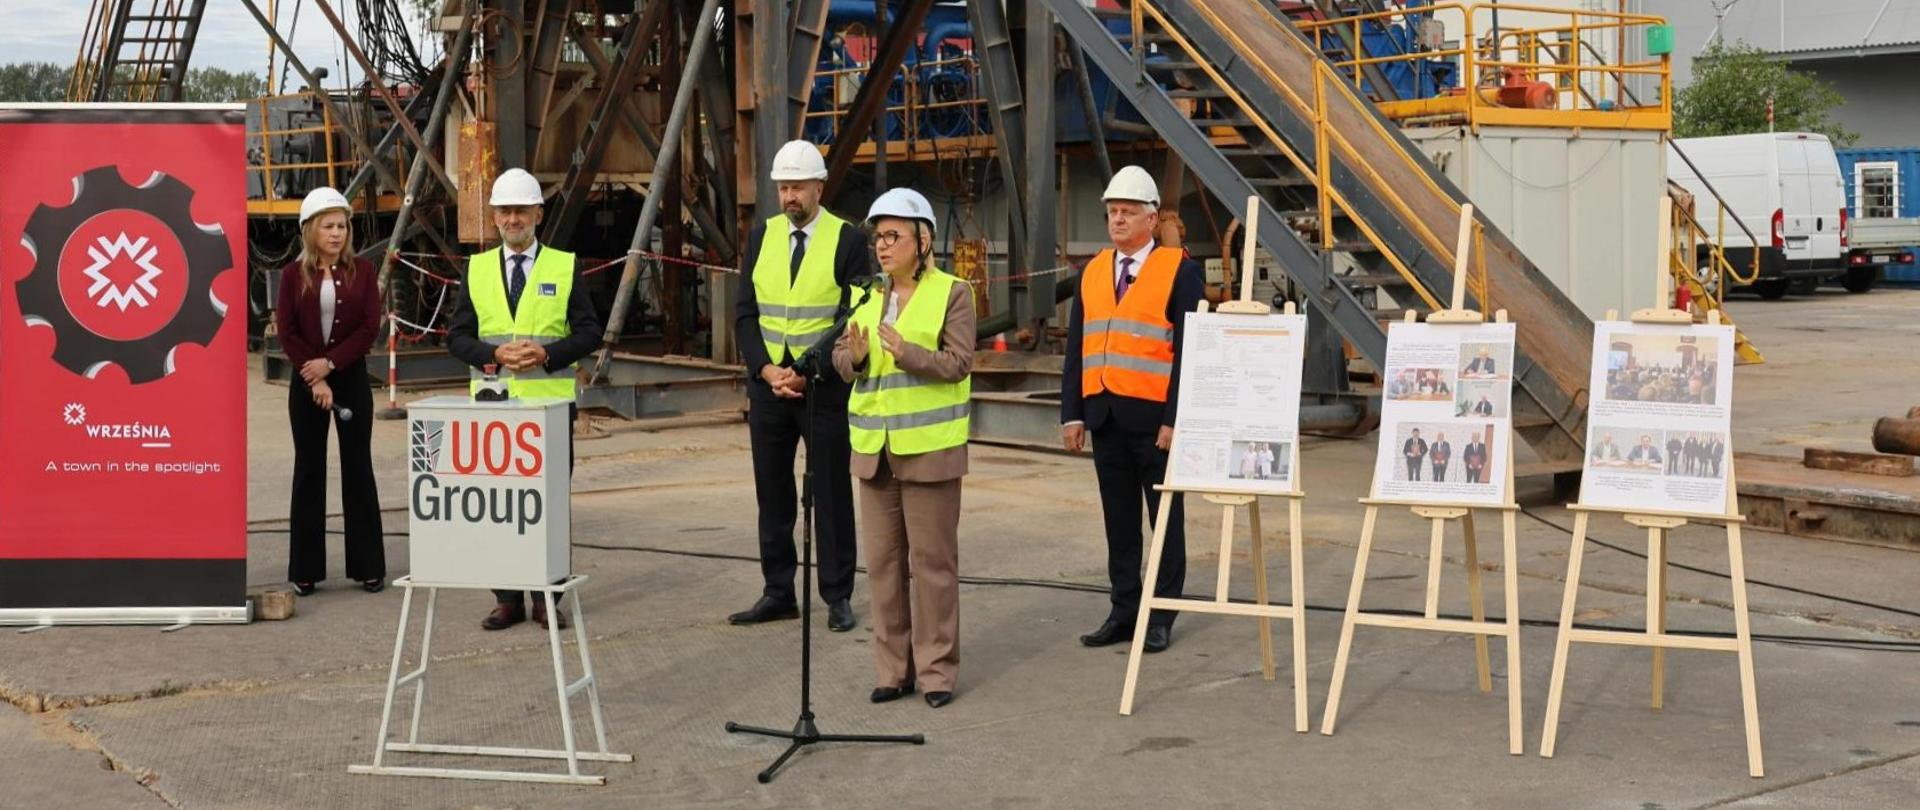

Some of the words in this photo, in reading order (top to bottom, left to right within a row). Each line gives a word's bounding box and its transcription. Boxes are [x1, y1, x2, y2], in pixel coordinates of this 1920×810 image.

[86, 421, 171, 438] WRZEŚNIA
[45, 460, 57, 472] A
[63, 461, 101, 472] town
[107, 461, 119, 472] in
[125, 460, 149, 472] the
[155, 461, 221, 474] spotlight
[452, 420, 543, 477] UOS
[412, 473, 543, 535] Group
